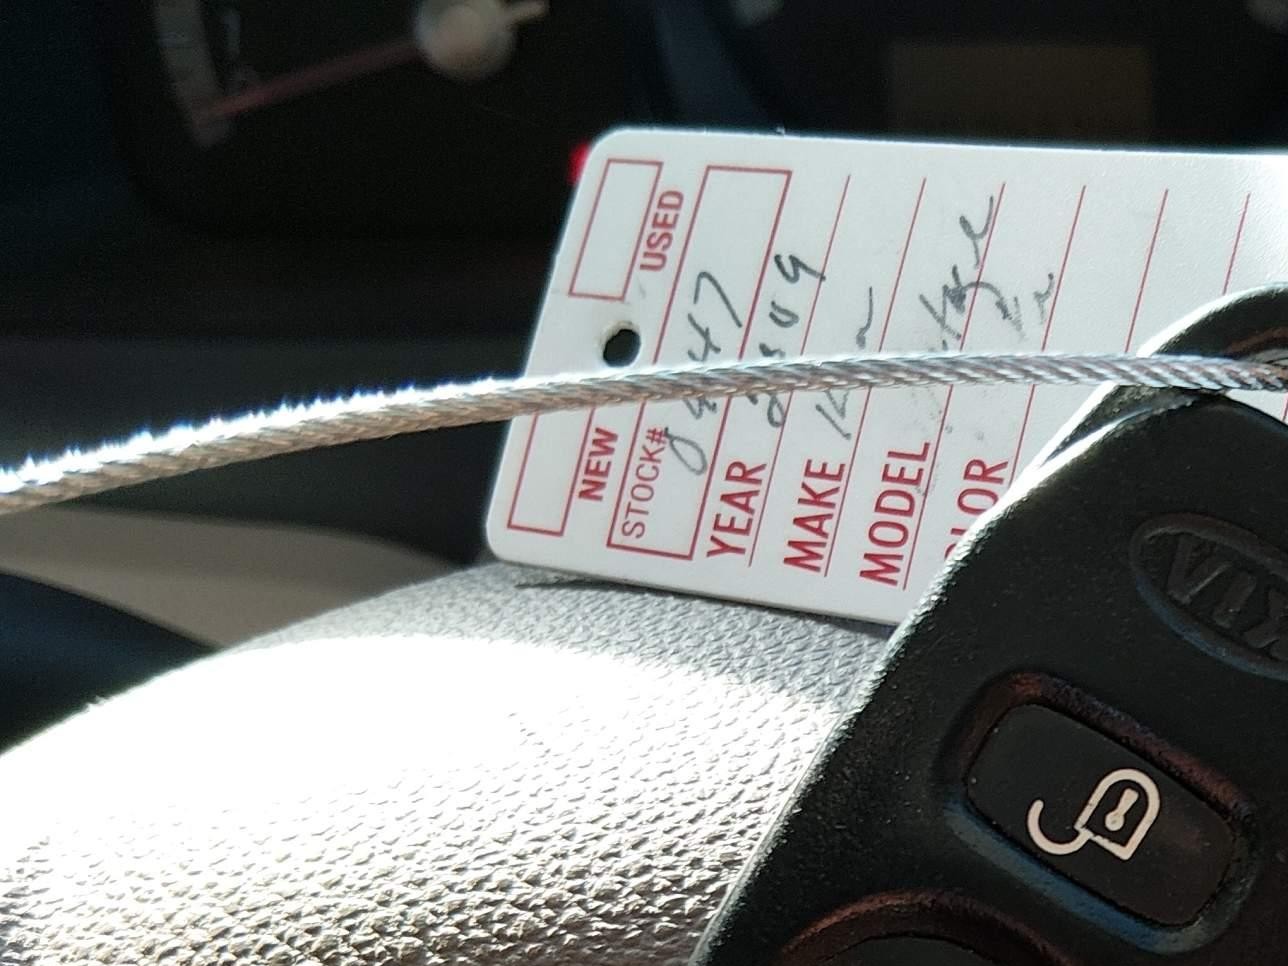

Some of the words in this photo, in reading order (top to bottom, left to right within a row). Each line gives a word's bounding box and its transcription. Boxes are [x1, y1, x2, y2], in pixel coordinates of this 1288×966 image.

[639, 190, 684, 272] USED
[580, 428, 618, 501] NEW
[622, 428, 669, 539] STOCK#
[706, 461, 767, 557] YEAR
[859, 442, 930, 586] MODEL
[944, 459, 1008, 560] OR
[783, 459, 846, 573] MAKE
